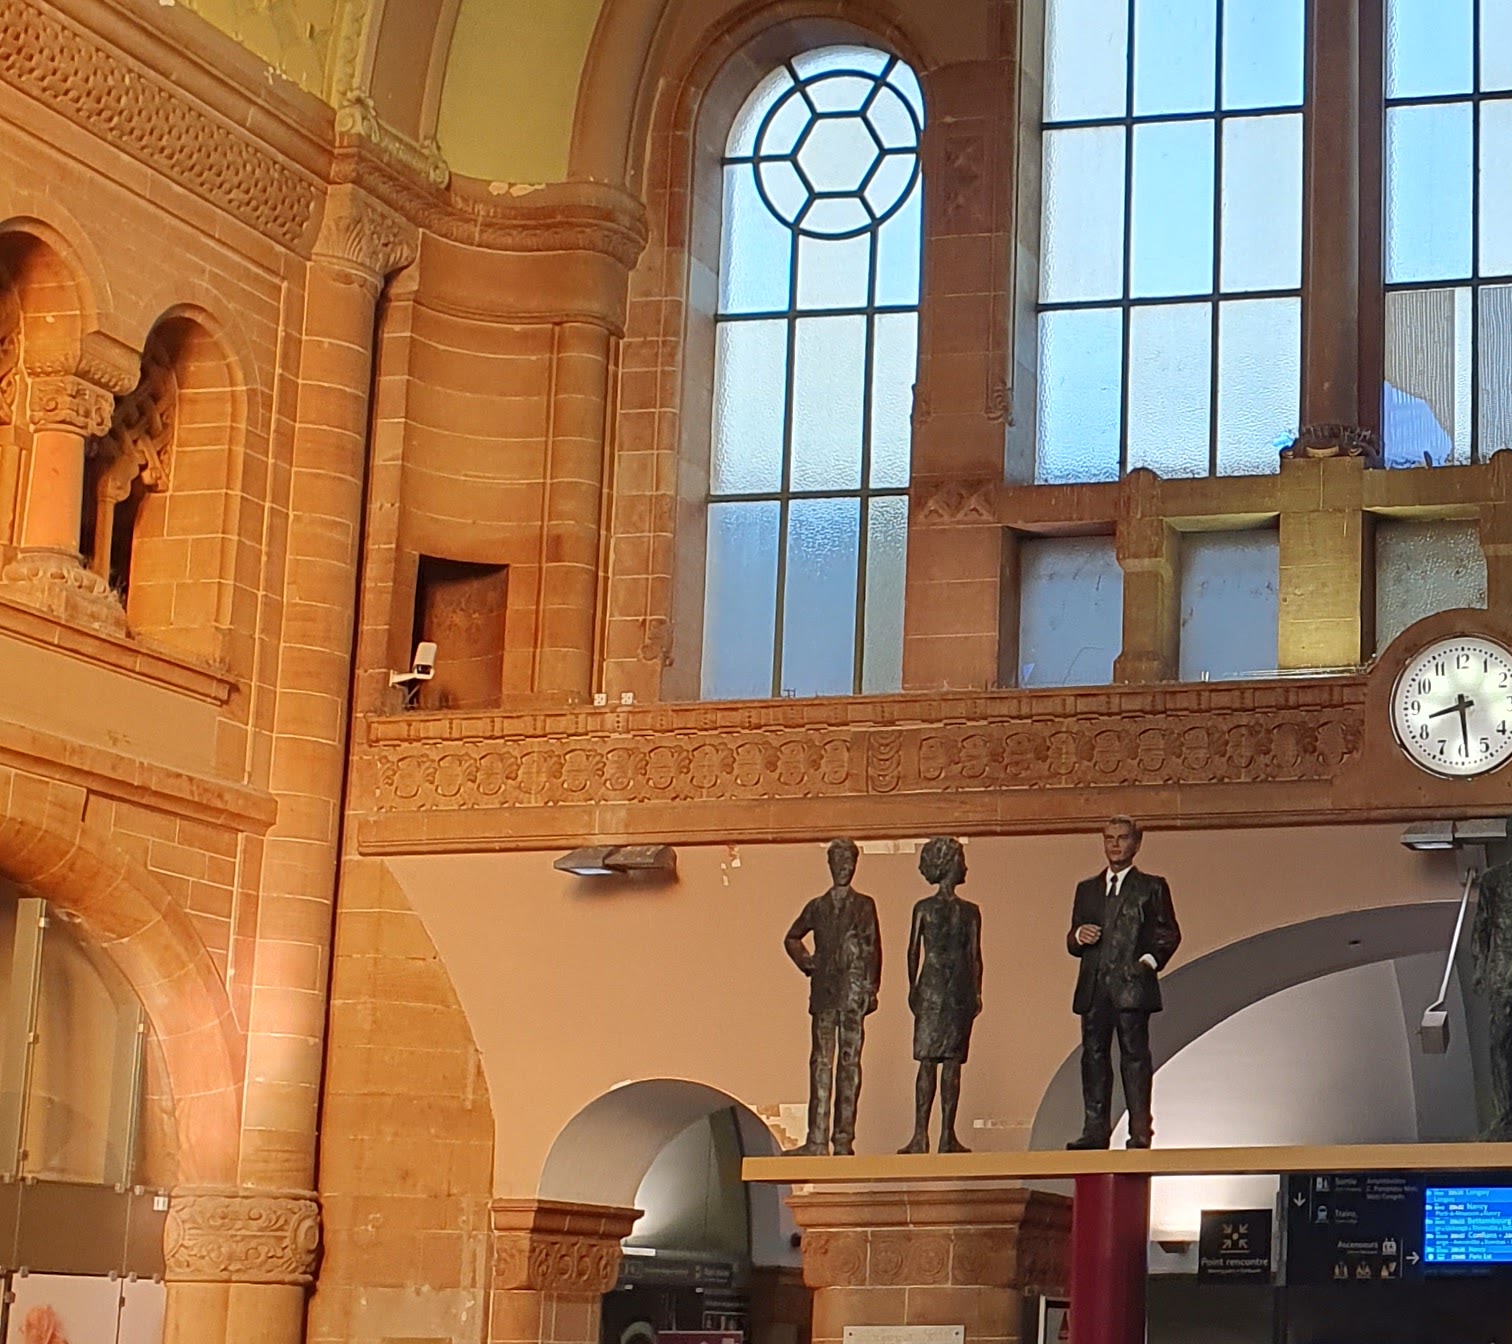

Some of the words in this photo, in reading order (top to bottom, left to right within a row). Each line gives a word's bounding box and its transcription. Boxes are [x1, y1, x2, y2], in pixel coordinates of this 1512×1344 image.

[1435, 662, 1445, 676] 11
[1456, 654, 1470, 670] 12
[1483, 658, 1488, 673] 1
[1418, 678, 1431, 694] 10
[1498, 672, 1508, 688] 2
[1411, 700, 1420, 715] 9
[1420, 724, 1429, 740] 8
[1496, 720, 1507, 735] 4
[1438, 740, 1447, 755] 7
[1480, 738, 1490, 753] 5
[1201, 1258, 1224, 1266] Point
